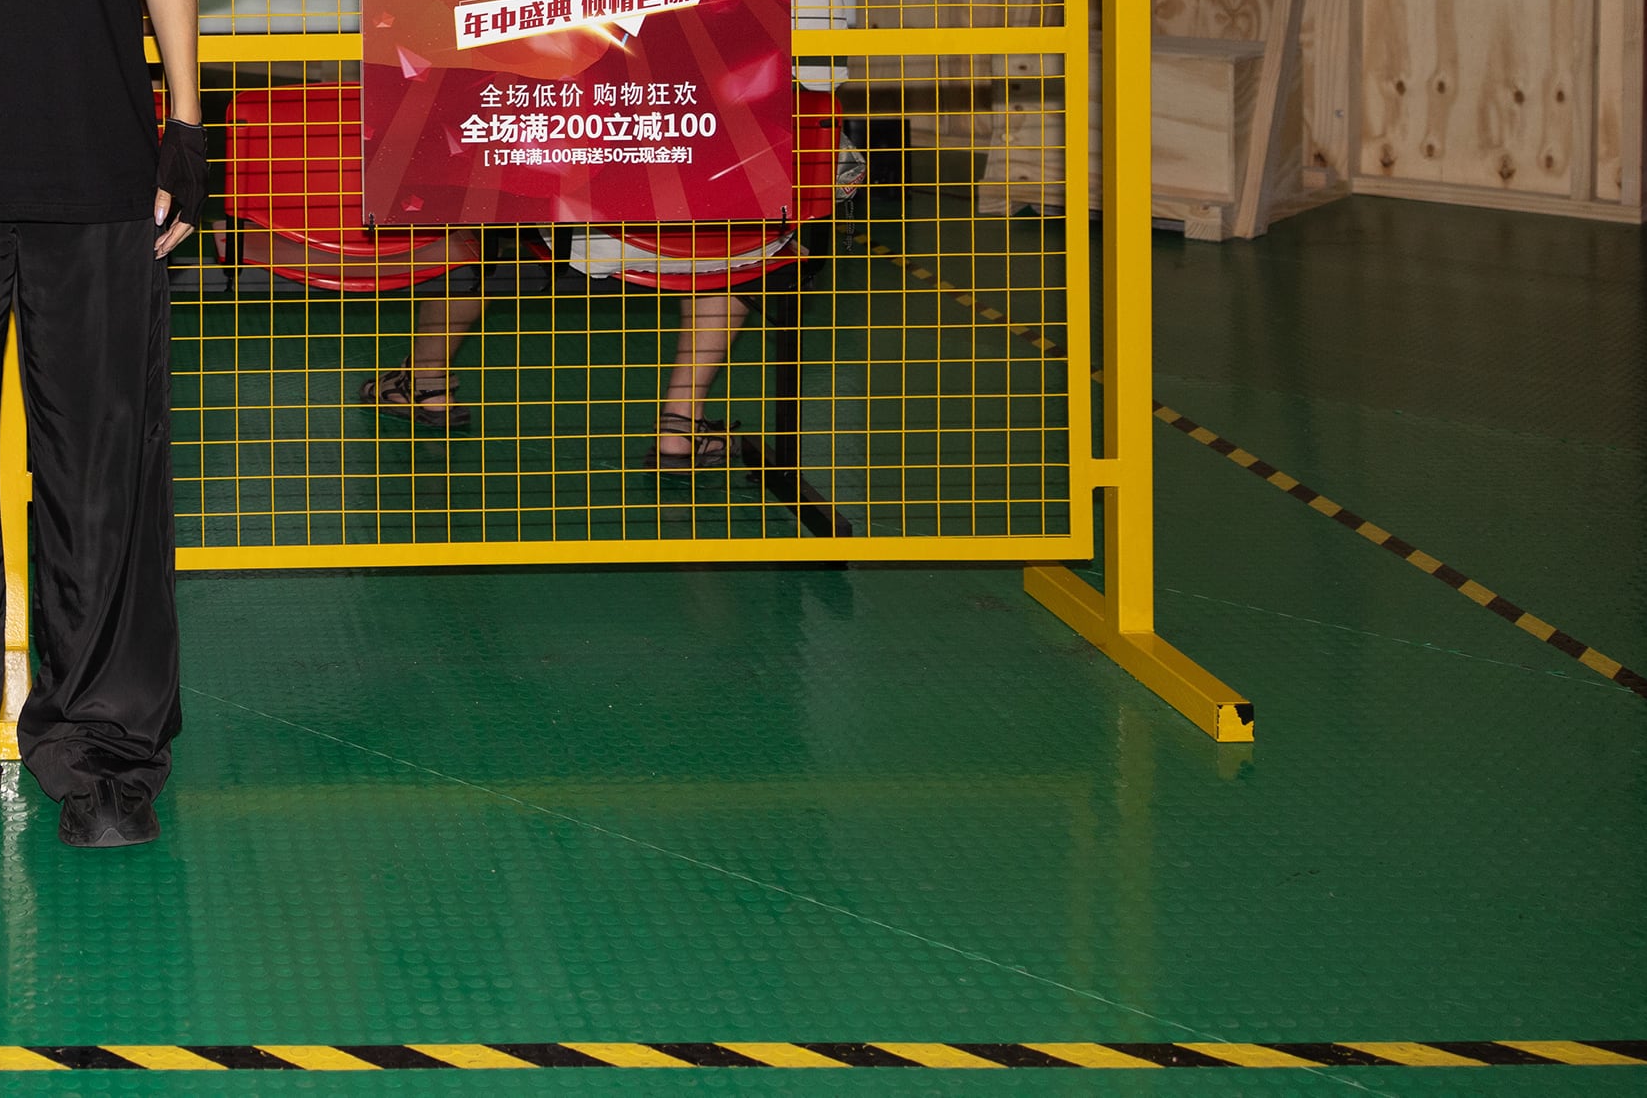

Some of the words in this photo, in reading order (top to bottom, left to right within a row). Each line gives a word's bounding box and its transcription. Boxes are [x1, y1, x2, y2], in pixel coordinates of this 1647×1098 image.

[479, 83, 584, 108] 全场低价
[593, 81, 698, 107] 购物狂欢
[460, 112, 717, 144] 全场满200立减100
